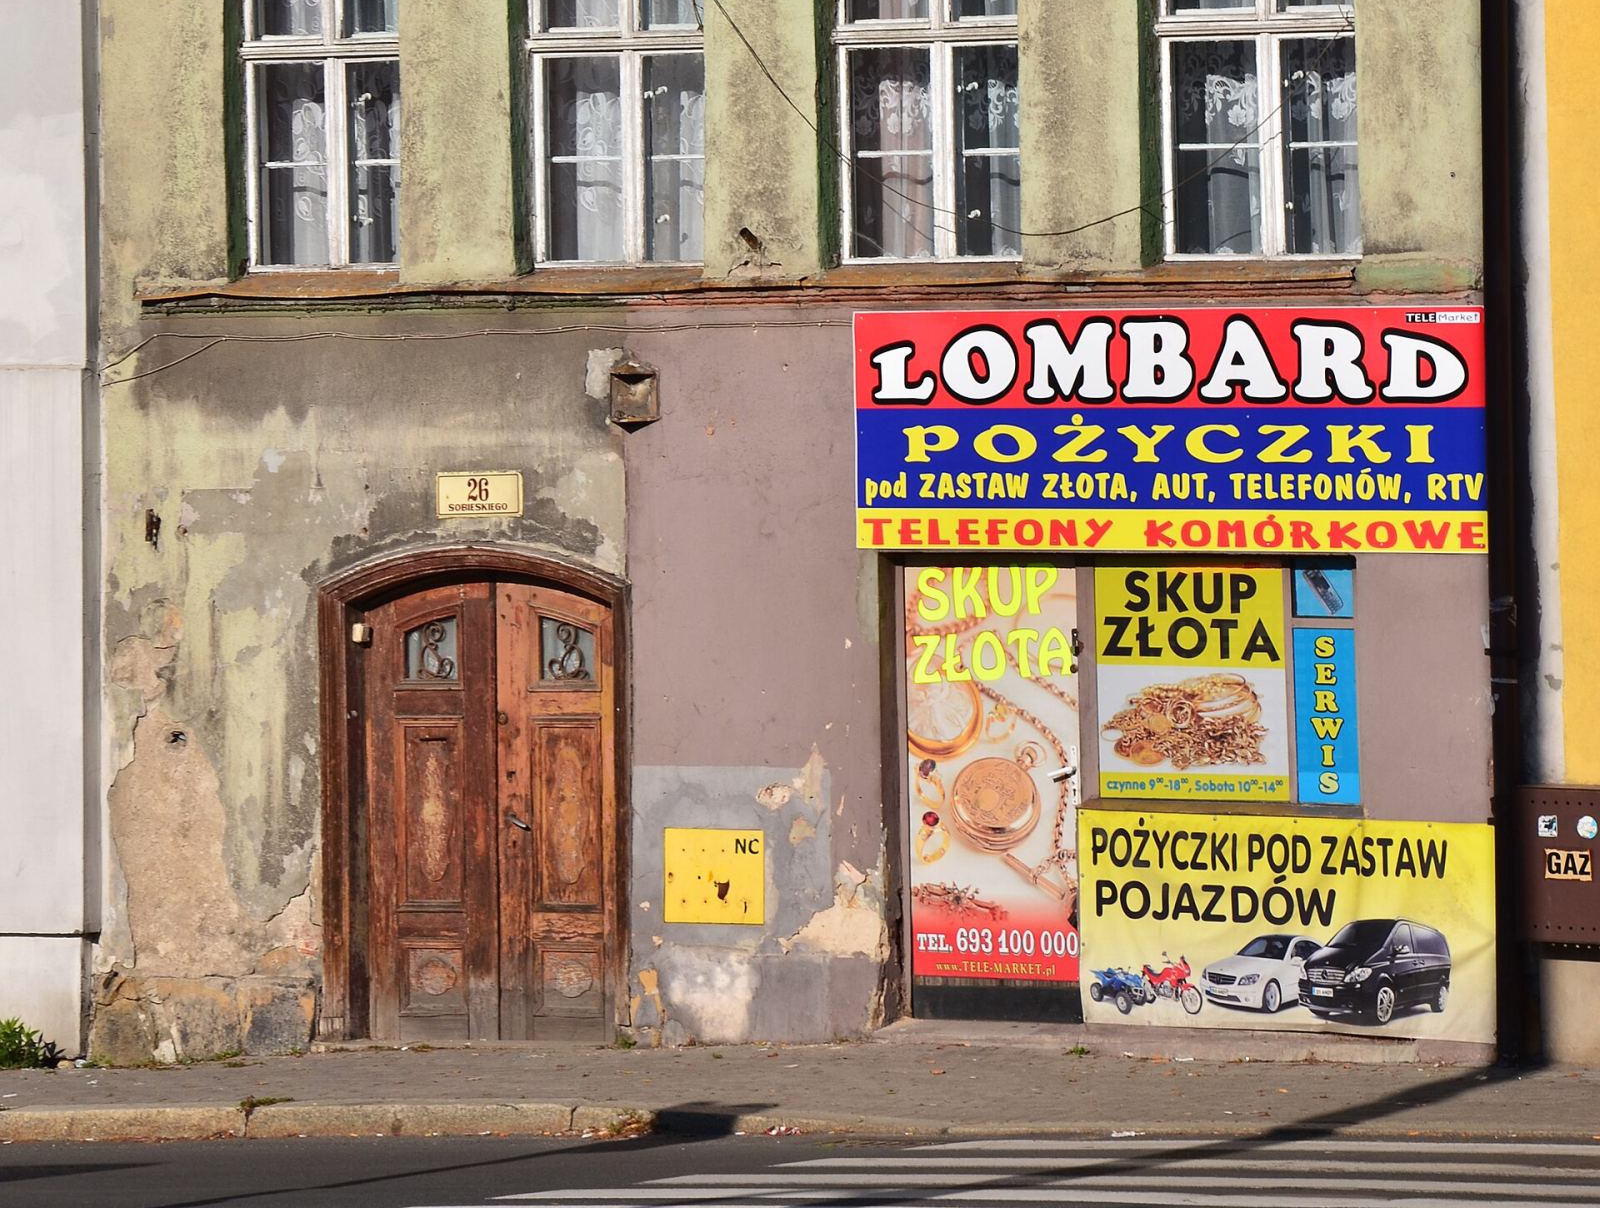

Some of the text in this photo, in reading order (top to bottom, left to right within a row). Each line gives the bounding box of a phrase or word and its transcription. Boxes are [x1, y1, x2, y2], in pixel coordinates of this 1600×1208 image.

[1405, 312, 1478, 323] TELE Market
[872, 314, 1468, 404] LOMBARD
[902, 414, 1436, 464] POŻYCZKI
[467, 477, 489, 501] 26
[865, 467, 1485, 505] pod ZASTAW ZŁOTA, AUT, TELEFONÓW, RTV
[448, 503, 508, 512] SOBIESKIEGO
[863, 513, 1486, 550] TELEFONY KOMÓRKOWE
[917, 563, 1059, 622] SKUP
[1124, 570, 1257, 614] SKUP
[912, 627, 1074, 684] ZŁOTA
[1102, 615, 1281, 663] ZŁOTA
[1311, 636, 1344, 795] SERWIS
[1106, 779, 1146, 793] czynne
[1195, 780, 1235, 793] Sobota
[735, 838, 760, 855] NC
[1092, 818, 1448, 880] POŻYCZKI POD ZASTAW
[1547, 852, 1591, 875] GAZ
[1095, 874, 1337, 927] POJAZDÓW
[916, 927, 1079, 957] TEL. 693 100 000
[935, 960, 1056, 977] www.TELE-MARKET.pl
